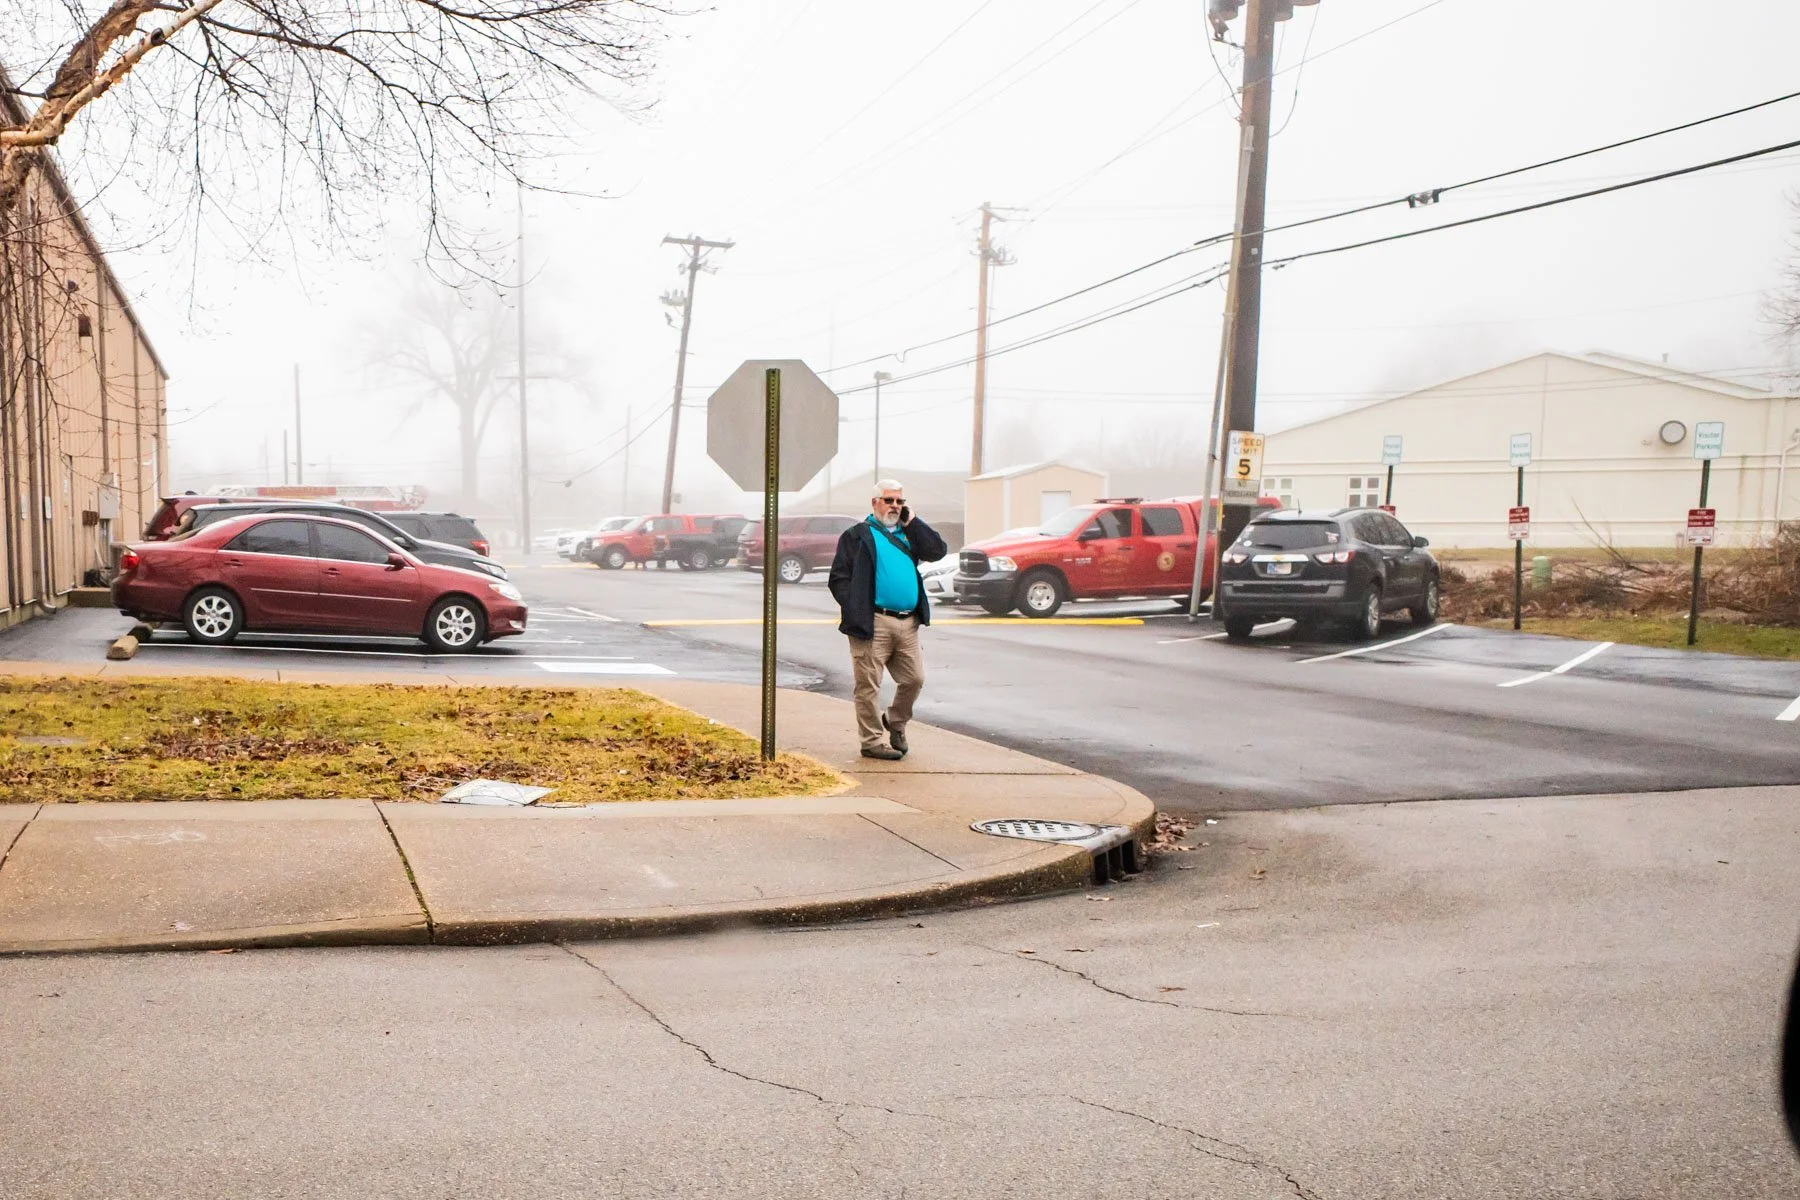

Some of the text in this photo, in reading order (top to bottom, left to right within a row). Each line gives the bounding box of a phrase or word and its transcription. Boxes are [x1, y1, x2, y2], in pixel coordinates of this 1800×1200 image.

[1232, 437, 1262, 447] SPEED
[1234, 447, 1257, 455] LIMIT
[1239, 459, 1251, 476] 5
